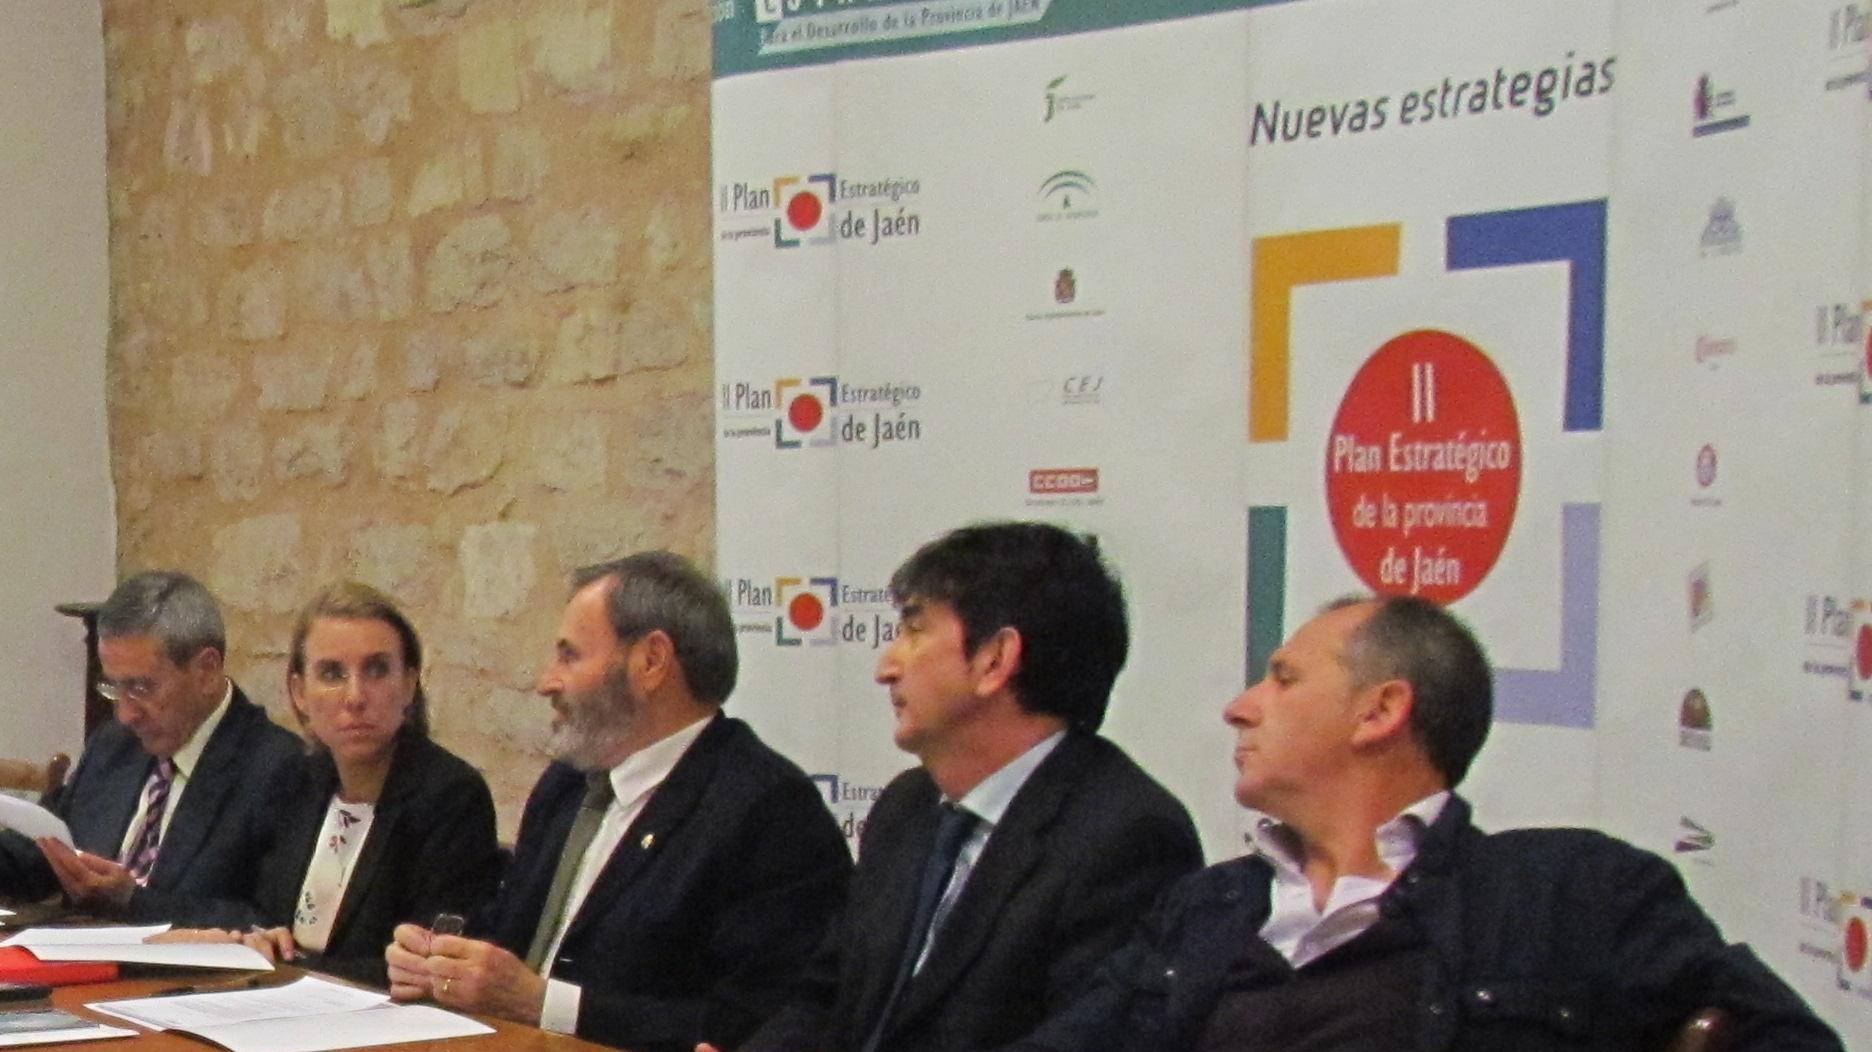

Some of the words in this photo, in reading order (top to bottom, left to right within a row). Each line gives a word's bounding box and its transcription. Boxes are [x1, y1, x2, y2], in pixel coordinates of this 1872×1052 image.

[806, 16, 878, 38] Desarrollo
[882, 13, 898, 31] de
[904, 10, 916, 28] la
[921, 6, 983, 25] Provincia
[1249, 96, 1391, 147] Nuevas
[1399, 50, 1618, 118] estrategias
[733, 182, 770, 211] Plan
[840, 178, 920, 201] Estratégico
[840, 210, 865, 239] de
[872, 206, 921, 246] Jaén
[735, 383, 771, 411] Plan
[841, 382, 921, 407] Estratégico
[1412, 362, 1435, 424] II
[841, 414, 866, 443] de
[872, 411, 921, 449] Jaén
[1334, 433, 1382, 473] Plan
[1389, 428, 1511, 483] Estratégico
[1353, 493, 1377, 528] de
[1382, 493, 1398, 528] la
[1404, 494, 1489, 538] provincia
[1381, 547, 1407, 585] de
[1410, 546, 1461, 595] Jaén
[738, 578, 773, 606] Plan
[842, 613, 866, 642] de
